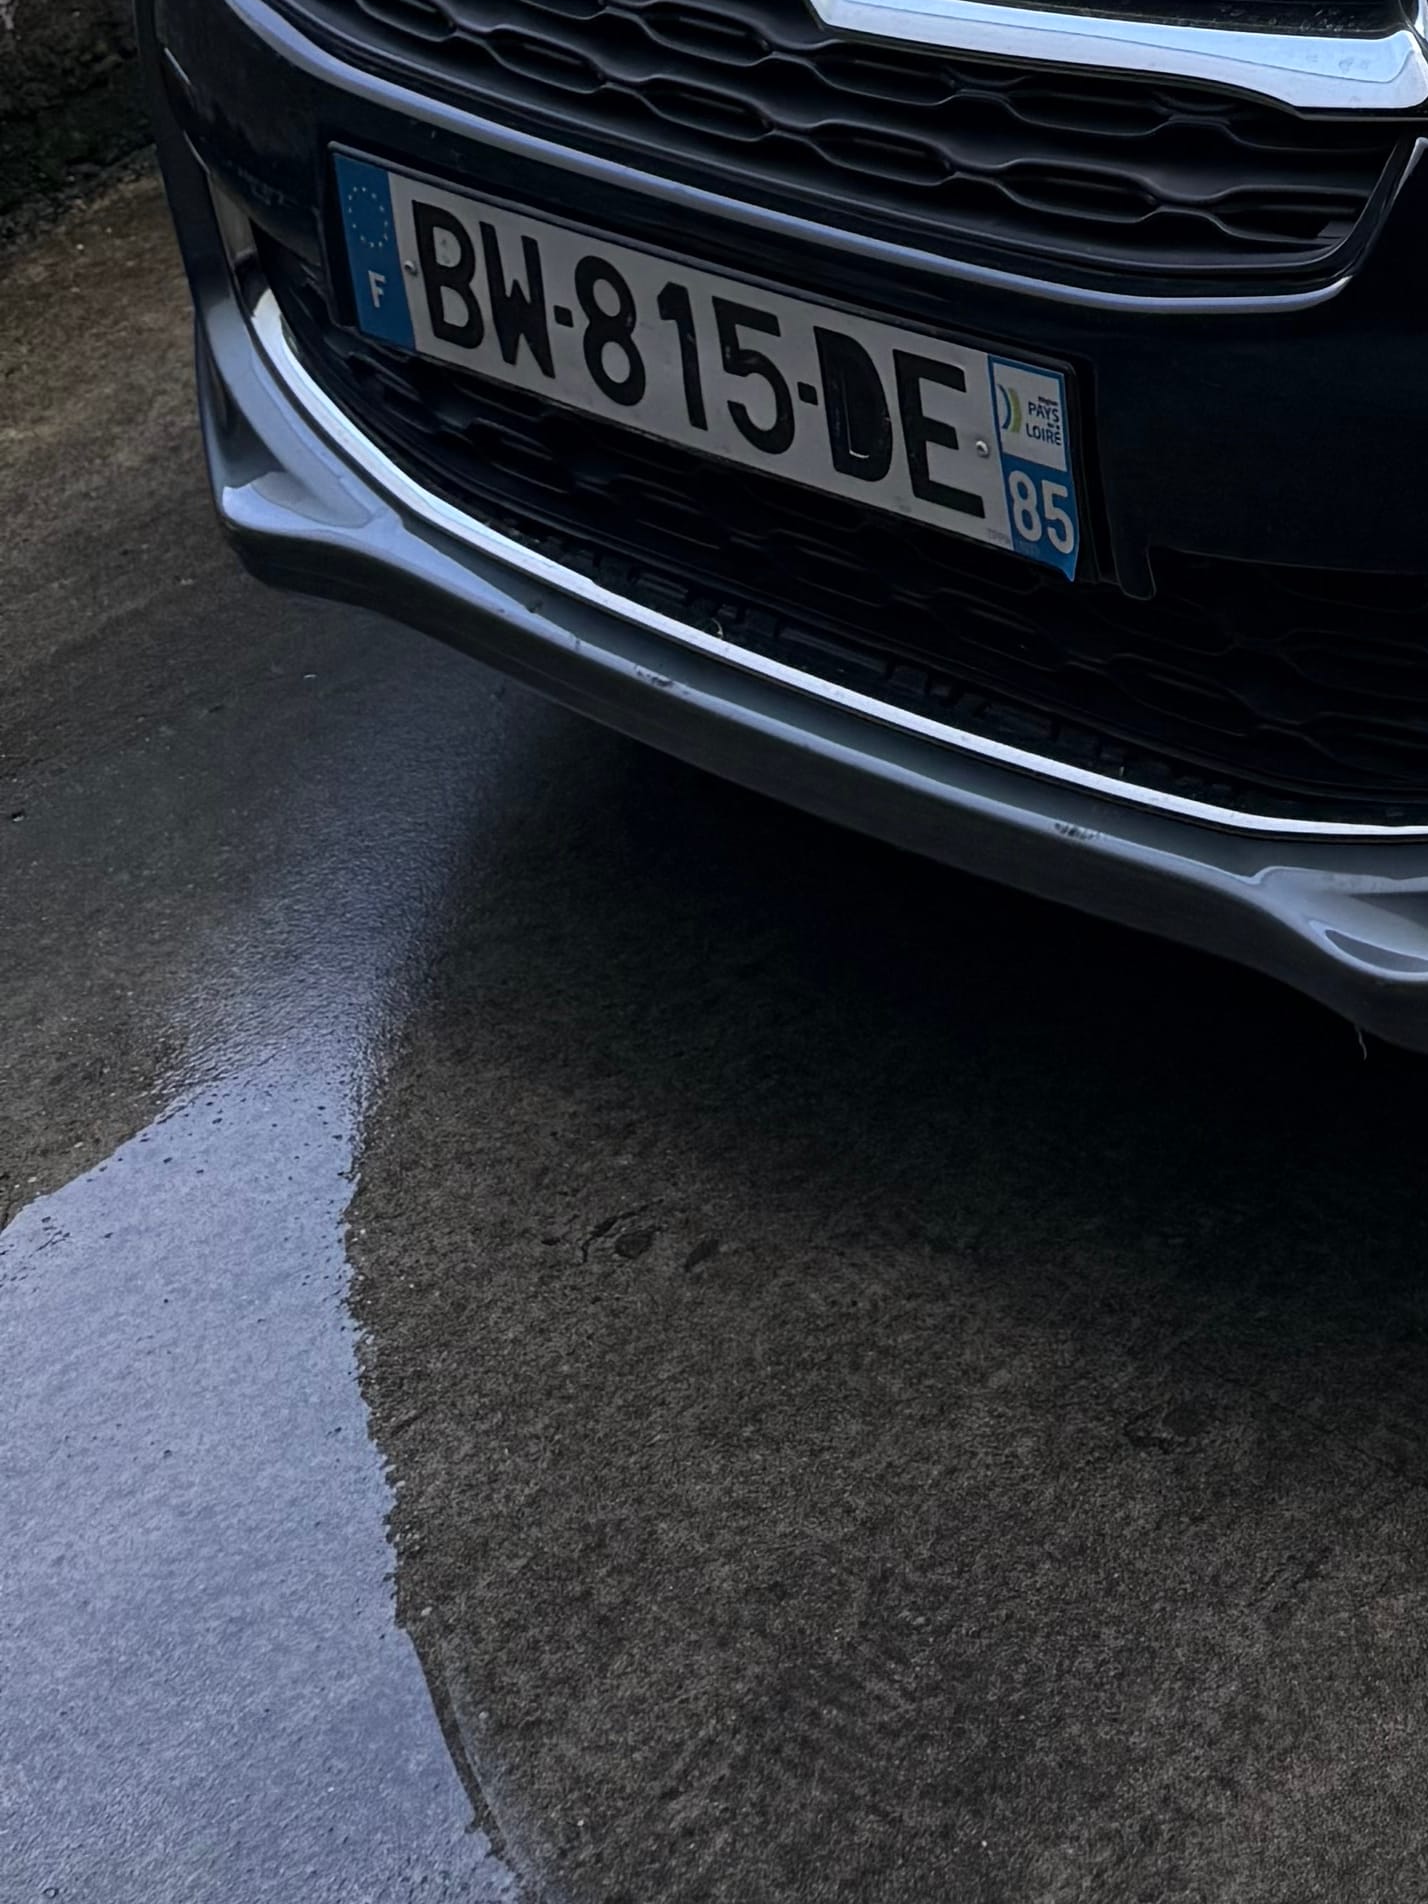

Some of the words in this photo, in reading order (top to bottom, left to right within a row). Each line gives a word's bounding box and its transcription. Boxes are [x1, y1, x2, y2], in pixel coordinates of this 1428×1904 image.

[368, 270, 386, 309] F
[412, 200, 985, 518] BW-815-DE
[1027, 400, 1060, 423] PAYS
[1026, 423, 1062, 447] LOIRE
[1008, 470, 1075, 555] 85
